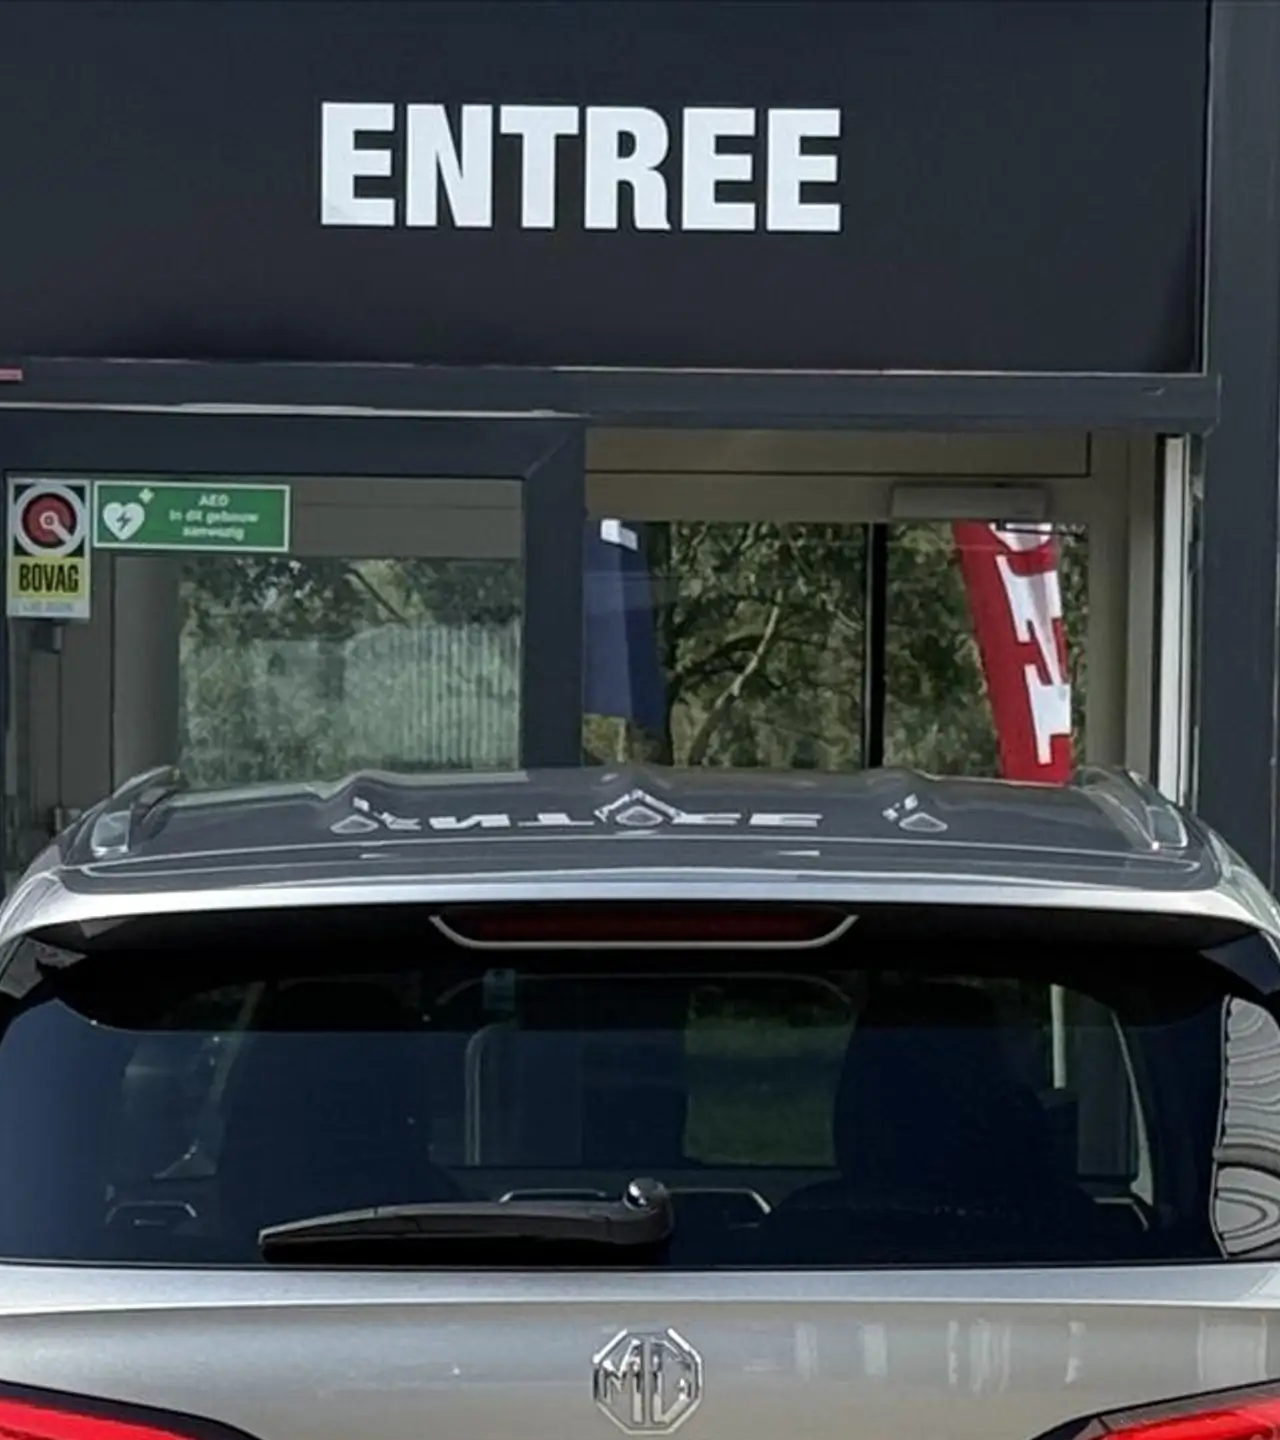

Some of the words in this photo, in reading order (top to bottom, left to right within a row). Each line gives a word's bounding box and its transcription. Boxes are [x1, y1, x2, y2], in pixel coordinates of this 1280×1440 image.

[321, 101, 841, 232] ENTREE
[19, 563, 79, 593] BOVAG
[599, 1334, 696, 1429] MG
